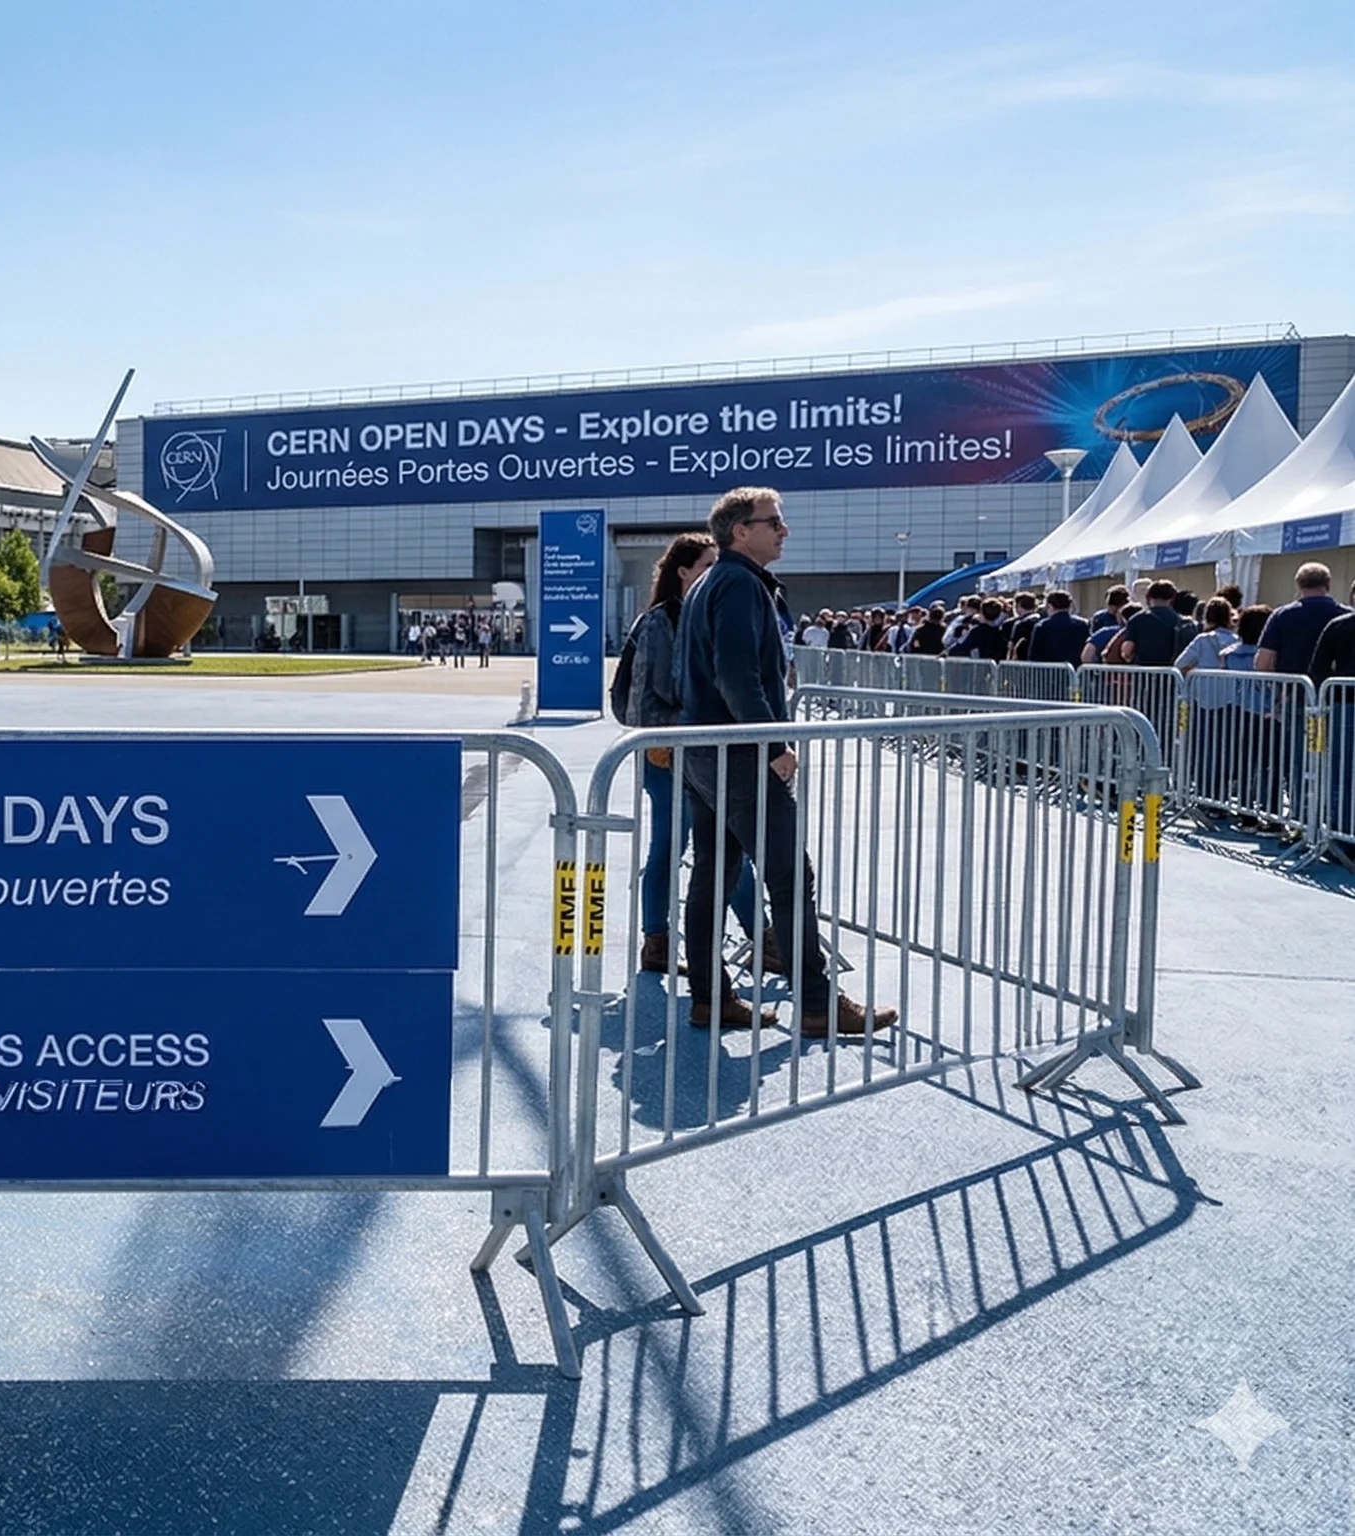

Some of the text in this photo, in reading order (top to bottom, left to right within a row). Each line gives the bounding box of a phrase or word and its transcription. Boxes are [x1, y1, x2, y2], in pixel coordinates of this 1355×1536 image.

[267, 427, 350, 456] CERN
[359, 421, 447, 452] OPEN
[458, 415, 545, 447] DAYS
[579, 408, 709, 445] Explore
[719, 404, 778, 433] the
[790, 393, 903, 429] limits!
[267, 461, 389, 491] Journées
[398, 458, 489, 485] Portes
[498, 451, 636, 482] Ouvertes
[669, 444, 813, 478] Explorez
[824, 439, 874, 467] les
[886, 429, 1012, 464] limites!
[560, 878, 576, 940] TME
[589, 879, 604, 940] TME
[35, 1033, 211, 1068] ACCESS
